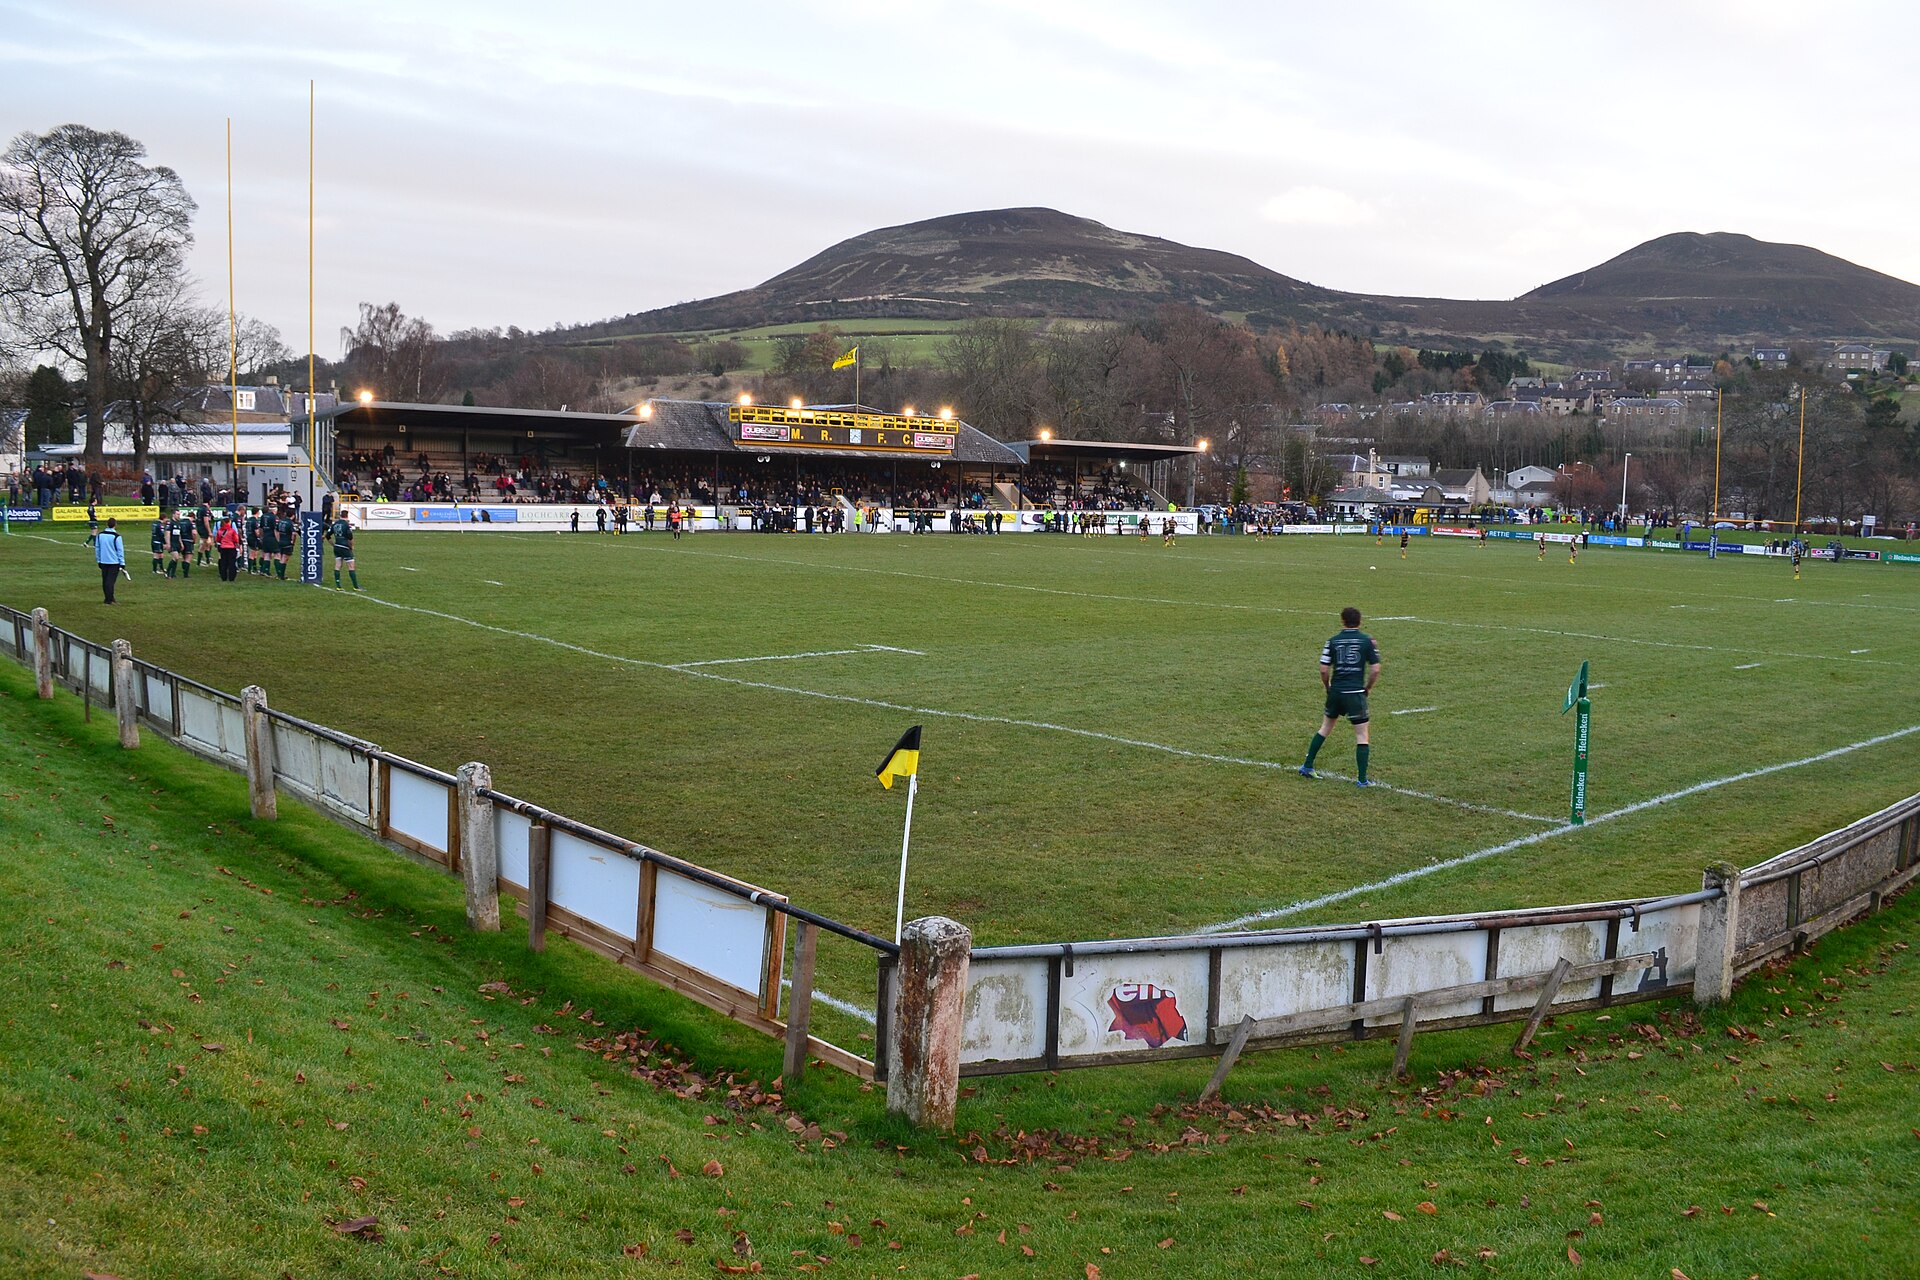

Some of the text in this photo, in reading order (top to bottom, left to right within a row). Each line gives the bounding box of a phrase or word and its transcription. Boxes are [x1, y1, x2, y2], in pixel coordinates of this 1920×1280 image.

[8, 509, 41, 517] Aberdeen
[521, 511, 600, 519] LOCHCARRN.CO
[1489, 530, 1510, 538] RETTIE
[307, 518, 320, 580] Aberdeen
[1652, 540, 1681, 549] Heineken
[1336, 644, 1362, 665] 15
[1578, 713, 1589, 752] Heineken
[1575, 772, 1586, 810] Heineken
